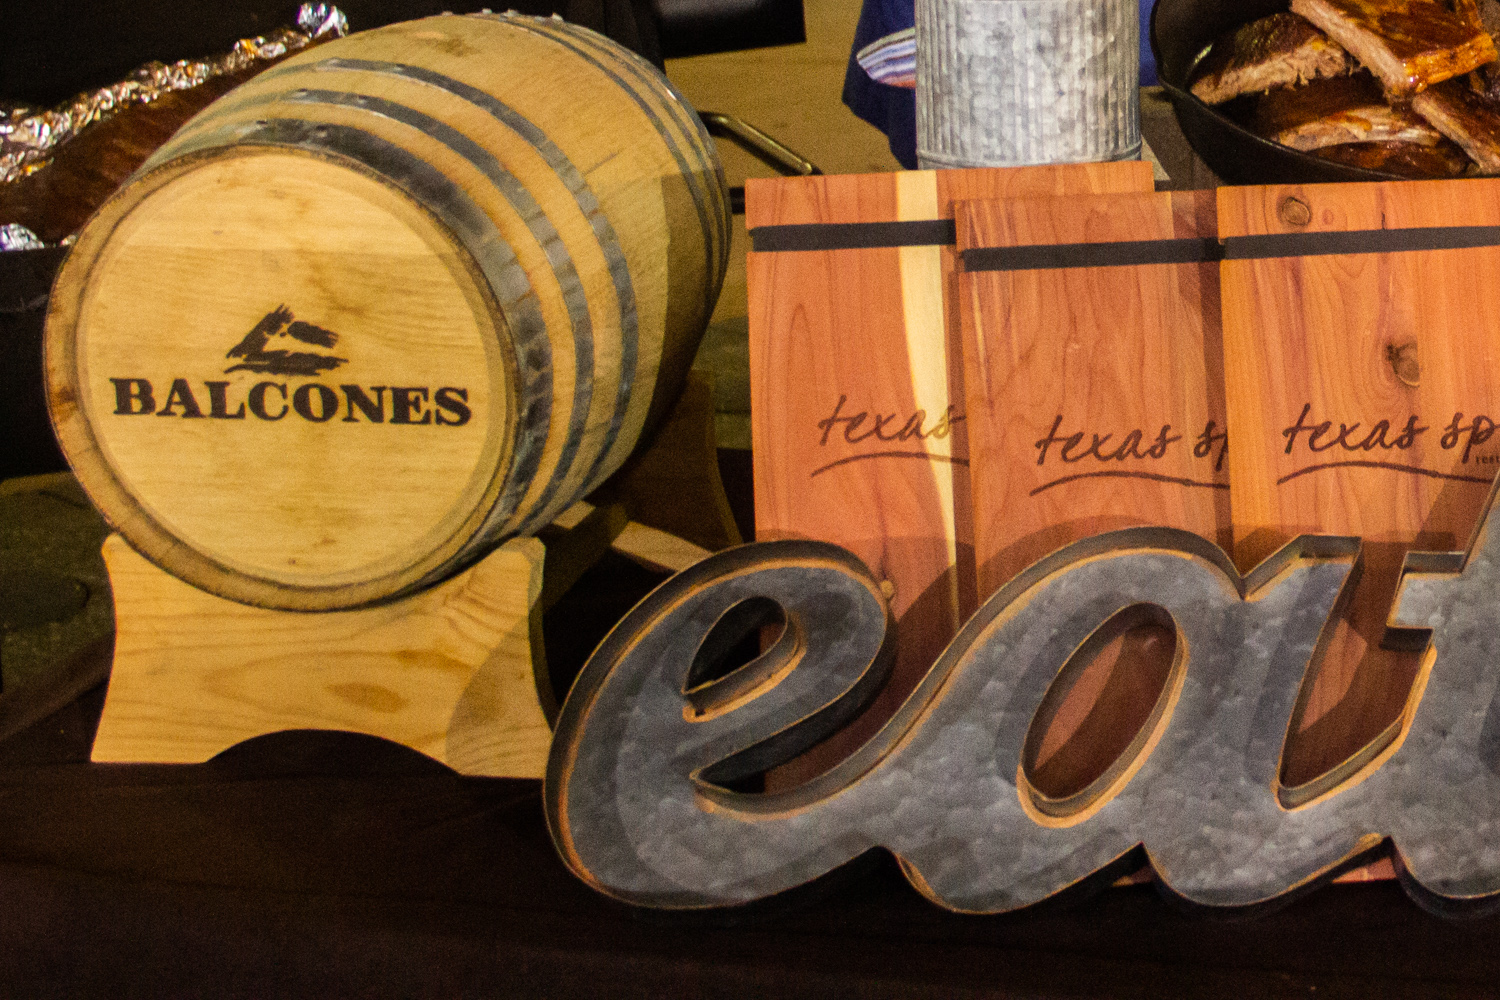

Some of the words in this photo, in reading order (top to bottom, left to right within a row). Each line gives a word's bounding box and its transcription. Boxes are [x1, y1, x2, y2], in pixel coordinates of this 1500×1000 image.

[108, 377, 473, 427] BALCONES
[817, 394, 967, 446] texas
[1282, 402, 1429, 454] texas
[1034, 414, 1183, 466] texas
